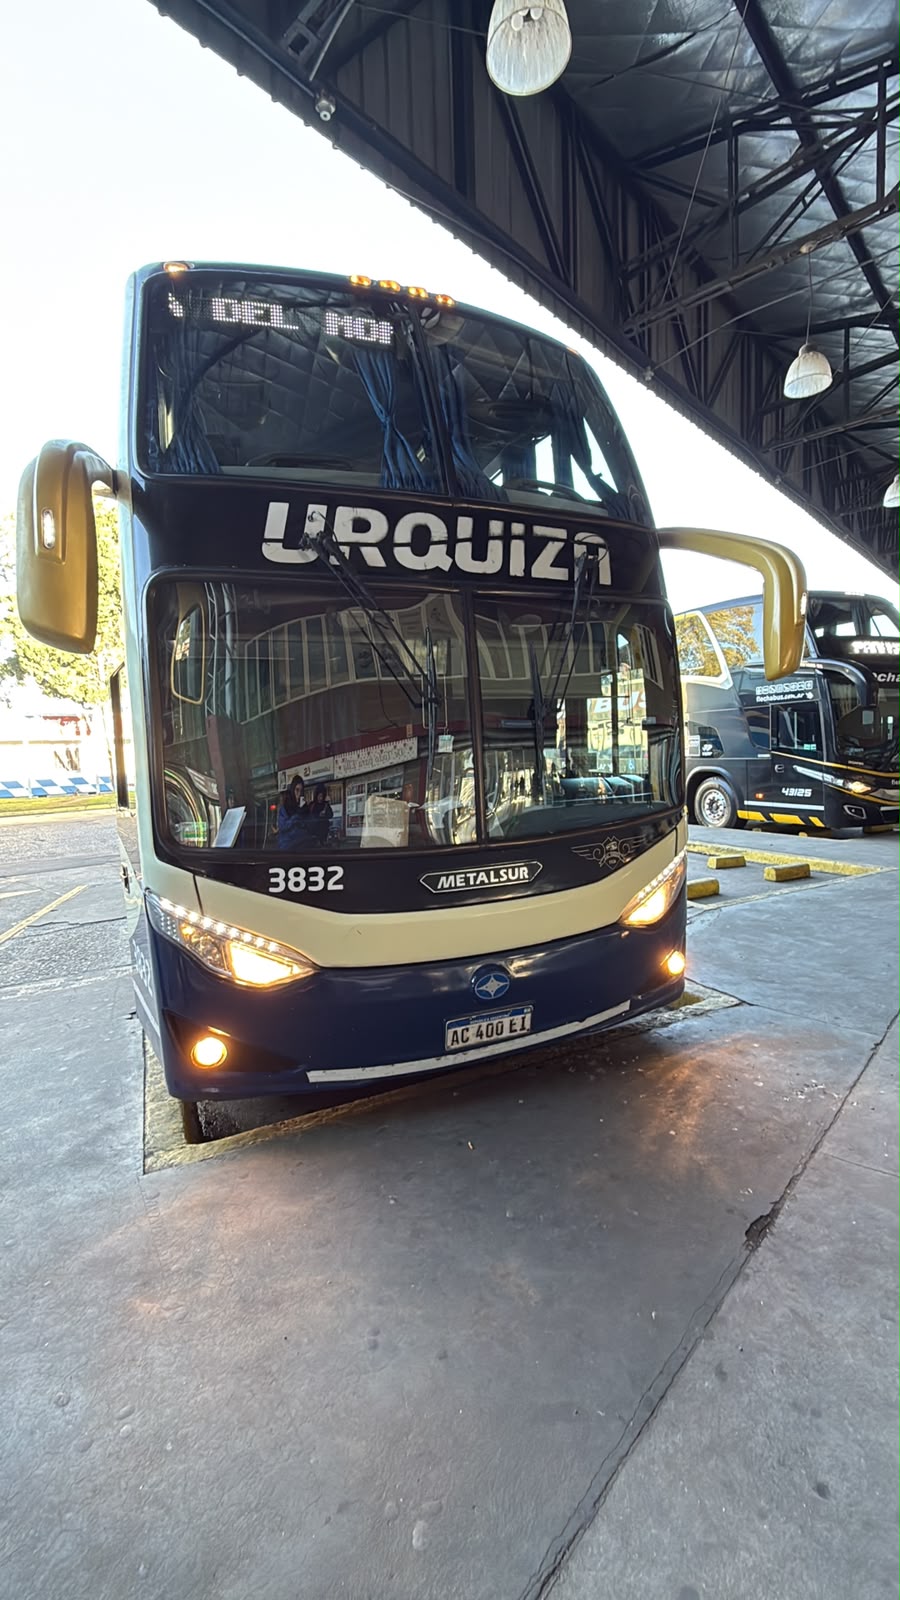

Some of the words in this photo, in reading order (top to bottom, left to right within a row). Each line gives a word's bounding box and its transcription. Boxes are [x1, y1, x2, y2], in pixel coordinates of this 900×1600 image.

[211, 297, 299, 330] DEL
[261, 501, 613, 586] URQUIZA
[781, 787, 812, 797] 43125
[268, 865, 345, 893] 3832
[437, 866, 529, 890] METALSUR
[450, 1027, 470, 1047] AC
[475, 1020, 504, 1040] 400
